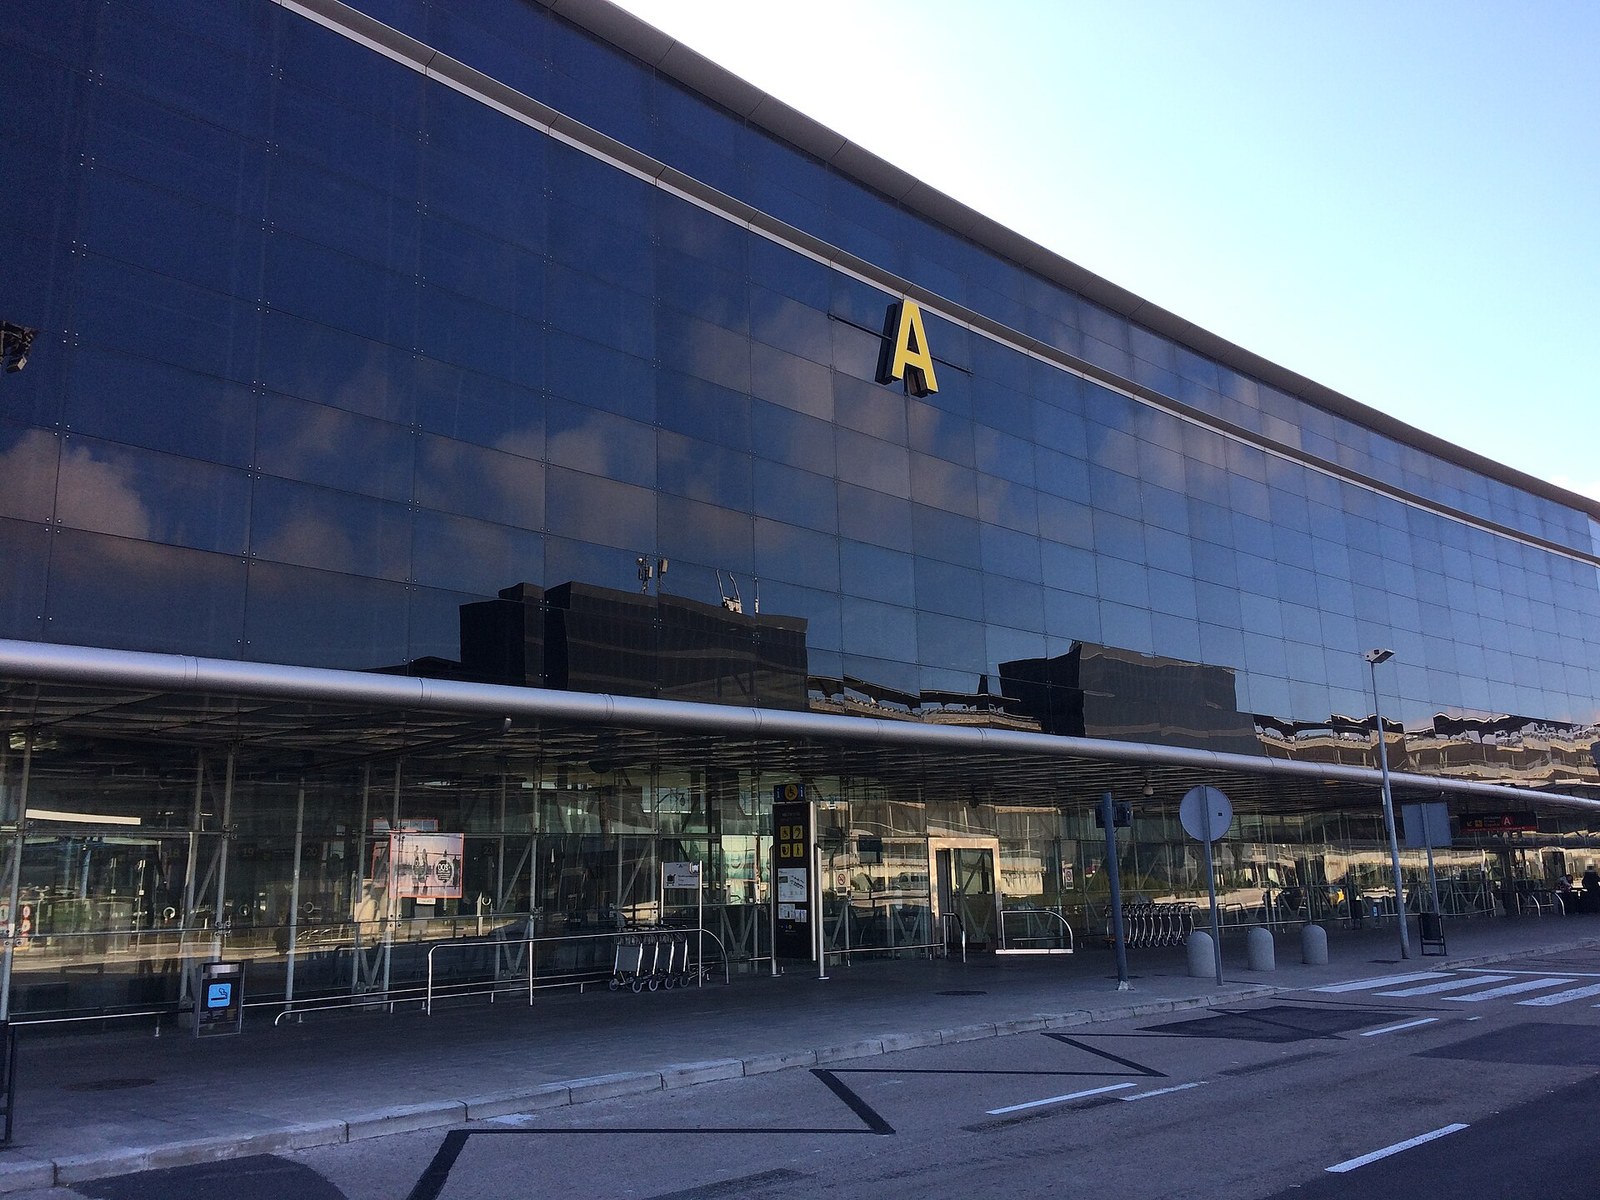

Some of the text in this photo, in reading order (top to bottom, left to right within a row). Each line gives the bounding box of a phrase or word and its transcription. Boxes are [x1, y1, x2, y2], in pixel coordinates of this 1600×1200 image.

[891, 299, 939, 392] A
[1504, 816, 1511, 825] A
[305, 847, 318, 857] 20
